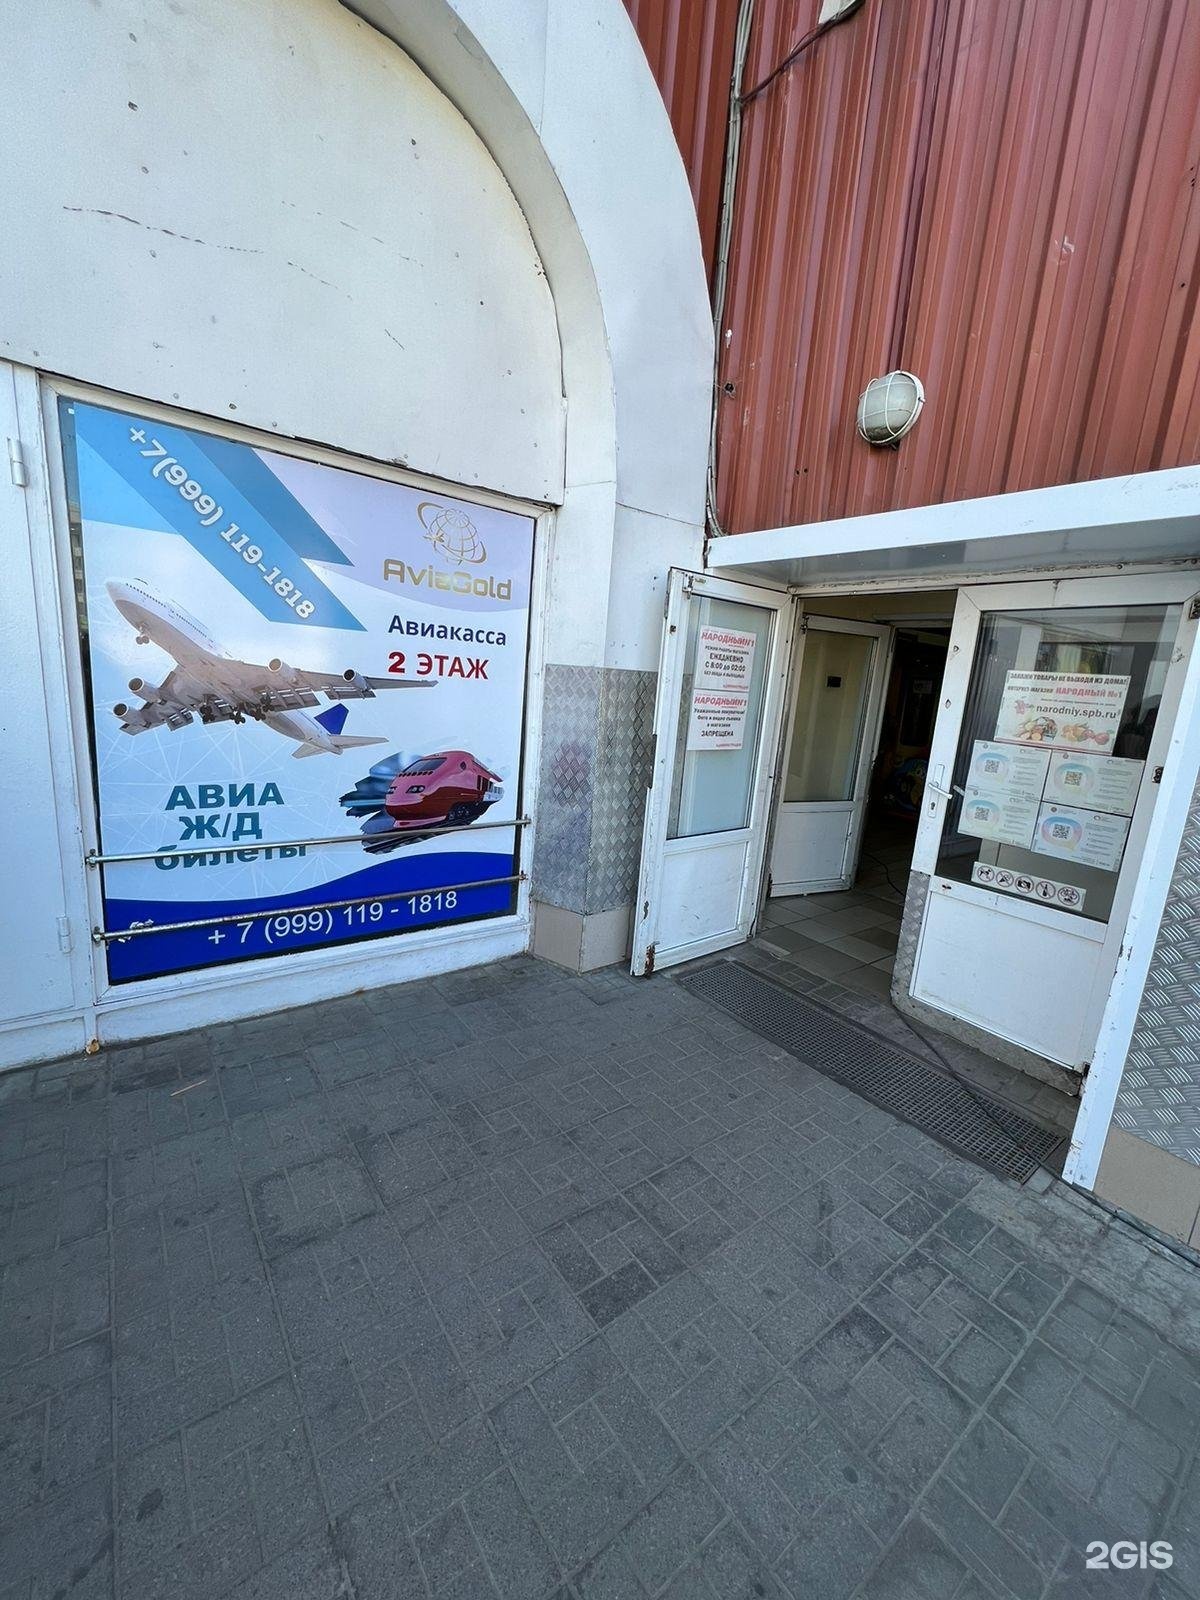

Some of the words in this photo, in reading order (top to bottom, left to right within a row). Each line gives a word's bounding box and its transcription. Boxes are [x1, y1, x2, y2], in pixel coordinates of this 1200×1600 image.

[129, 427, 224, 526] +7(999)
[220, 523, 316, 619] 119-1818
[383, 558, 512, 600] AviaGold
[388, 614, 507, 646] Авиакасса
[388, 651, 406, 674] 2
[416, 653, 489, 680] ЭТАЖ
[710, 652, 744, 664] ЕЖЕДНЕВНО
[1056, 687, 1106, 698] НАРОДНЫЙ
[1036, 704, 1118, 719] narodniy.spb.ru
[701, 730, 734, 738] ЗАПРЕЩЕНА
[165, 782, 285, 811] АВИА
[178, 812, 263, 841] Ж/Д
[154, 842, 307, 871] билеты
[208, 929, 226, 945] +
[237, 921, 254, 944] 7
[264, 909, 333, 944] (999)
[343, 902, 384, 926] 119
[407, 890, 458, 916] 1818
